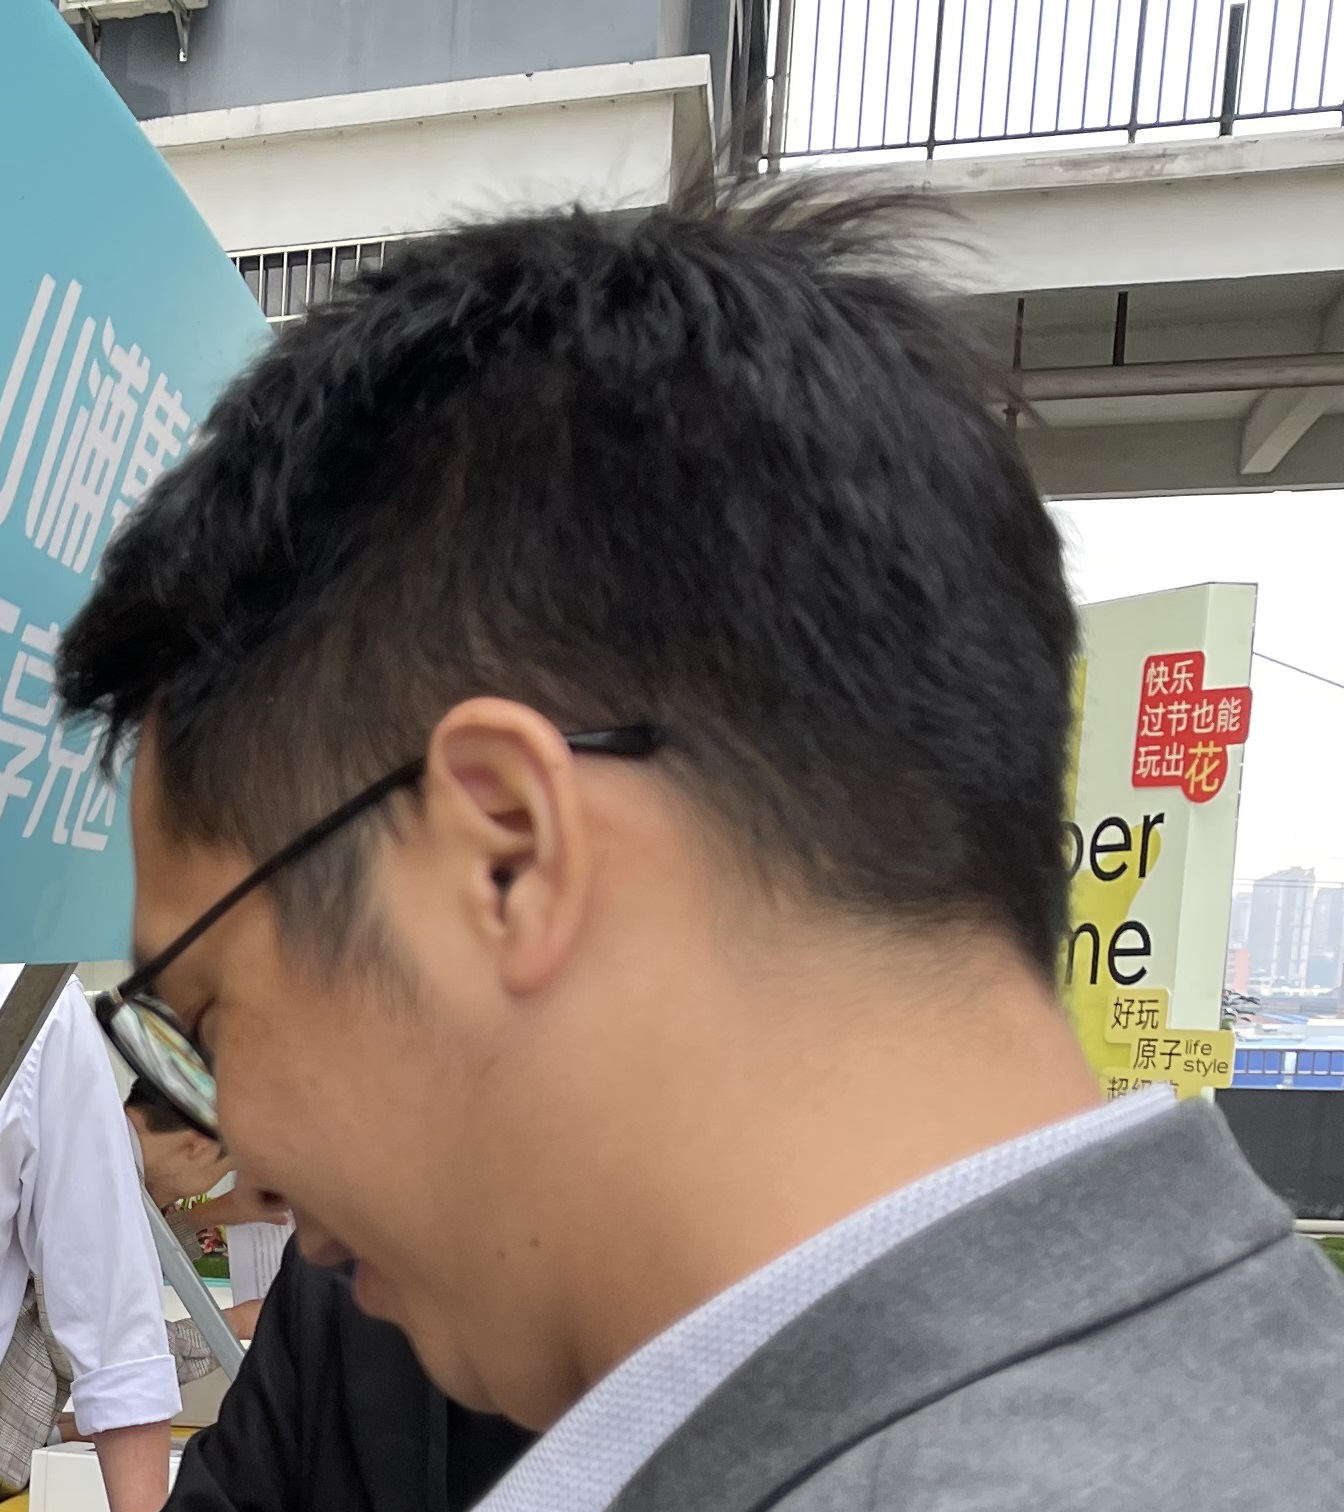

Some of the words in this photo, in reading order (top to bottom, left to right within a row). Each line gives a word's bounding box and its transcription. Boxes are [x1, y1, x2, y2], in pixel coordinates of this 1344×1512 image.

[1146, 659, 1194, 697] 快乐
[1140, 696, 1242, 737] 过节也能
[1135, 740, 1224, 795] 玩出花
[1111, 996, 1161, 1030] 好玩
[1133, 1037, 1182, 1070] 原子
[1185, 1039, 1213, 1055] life
[1183, 1059, 1230, 1078] style
